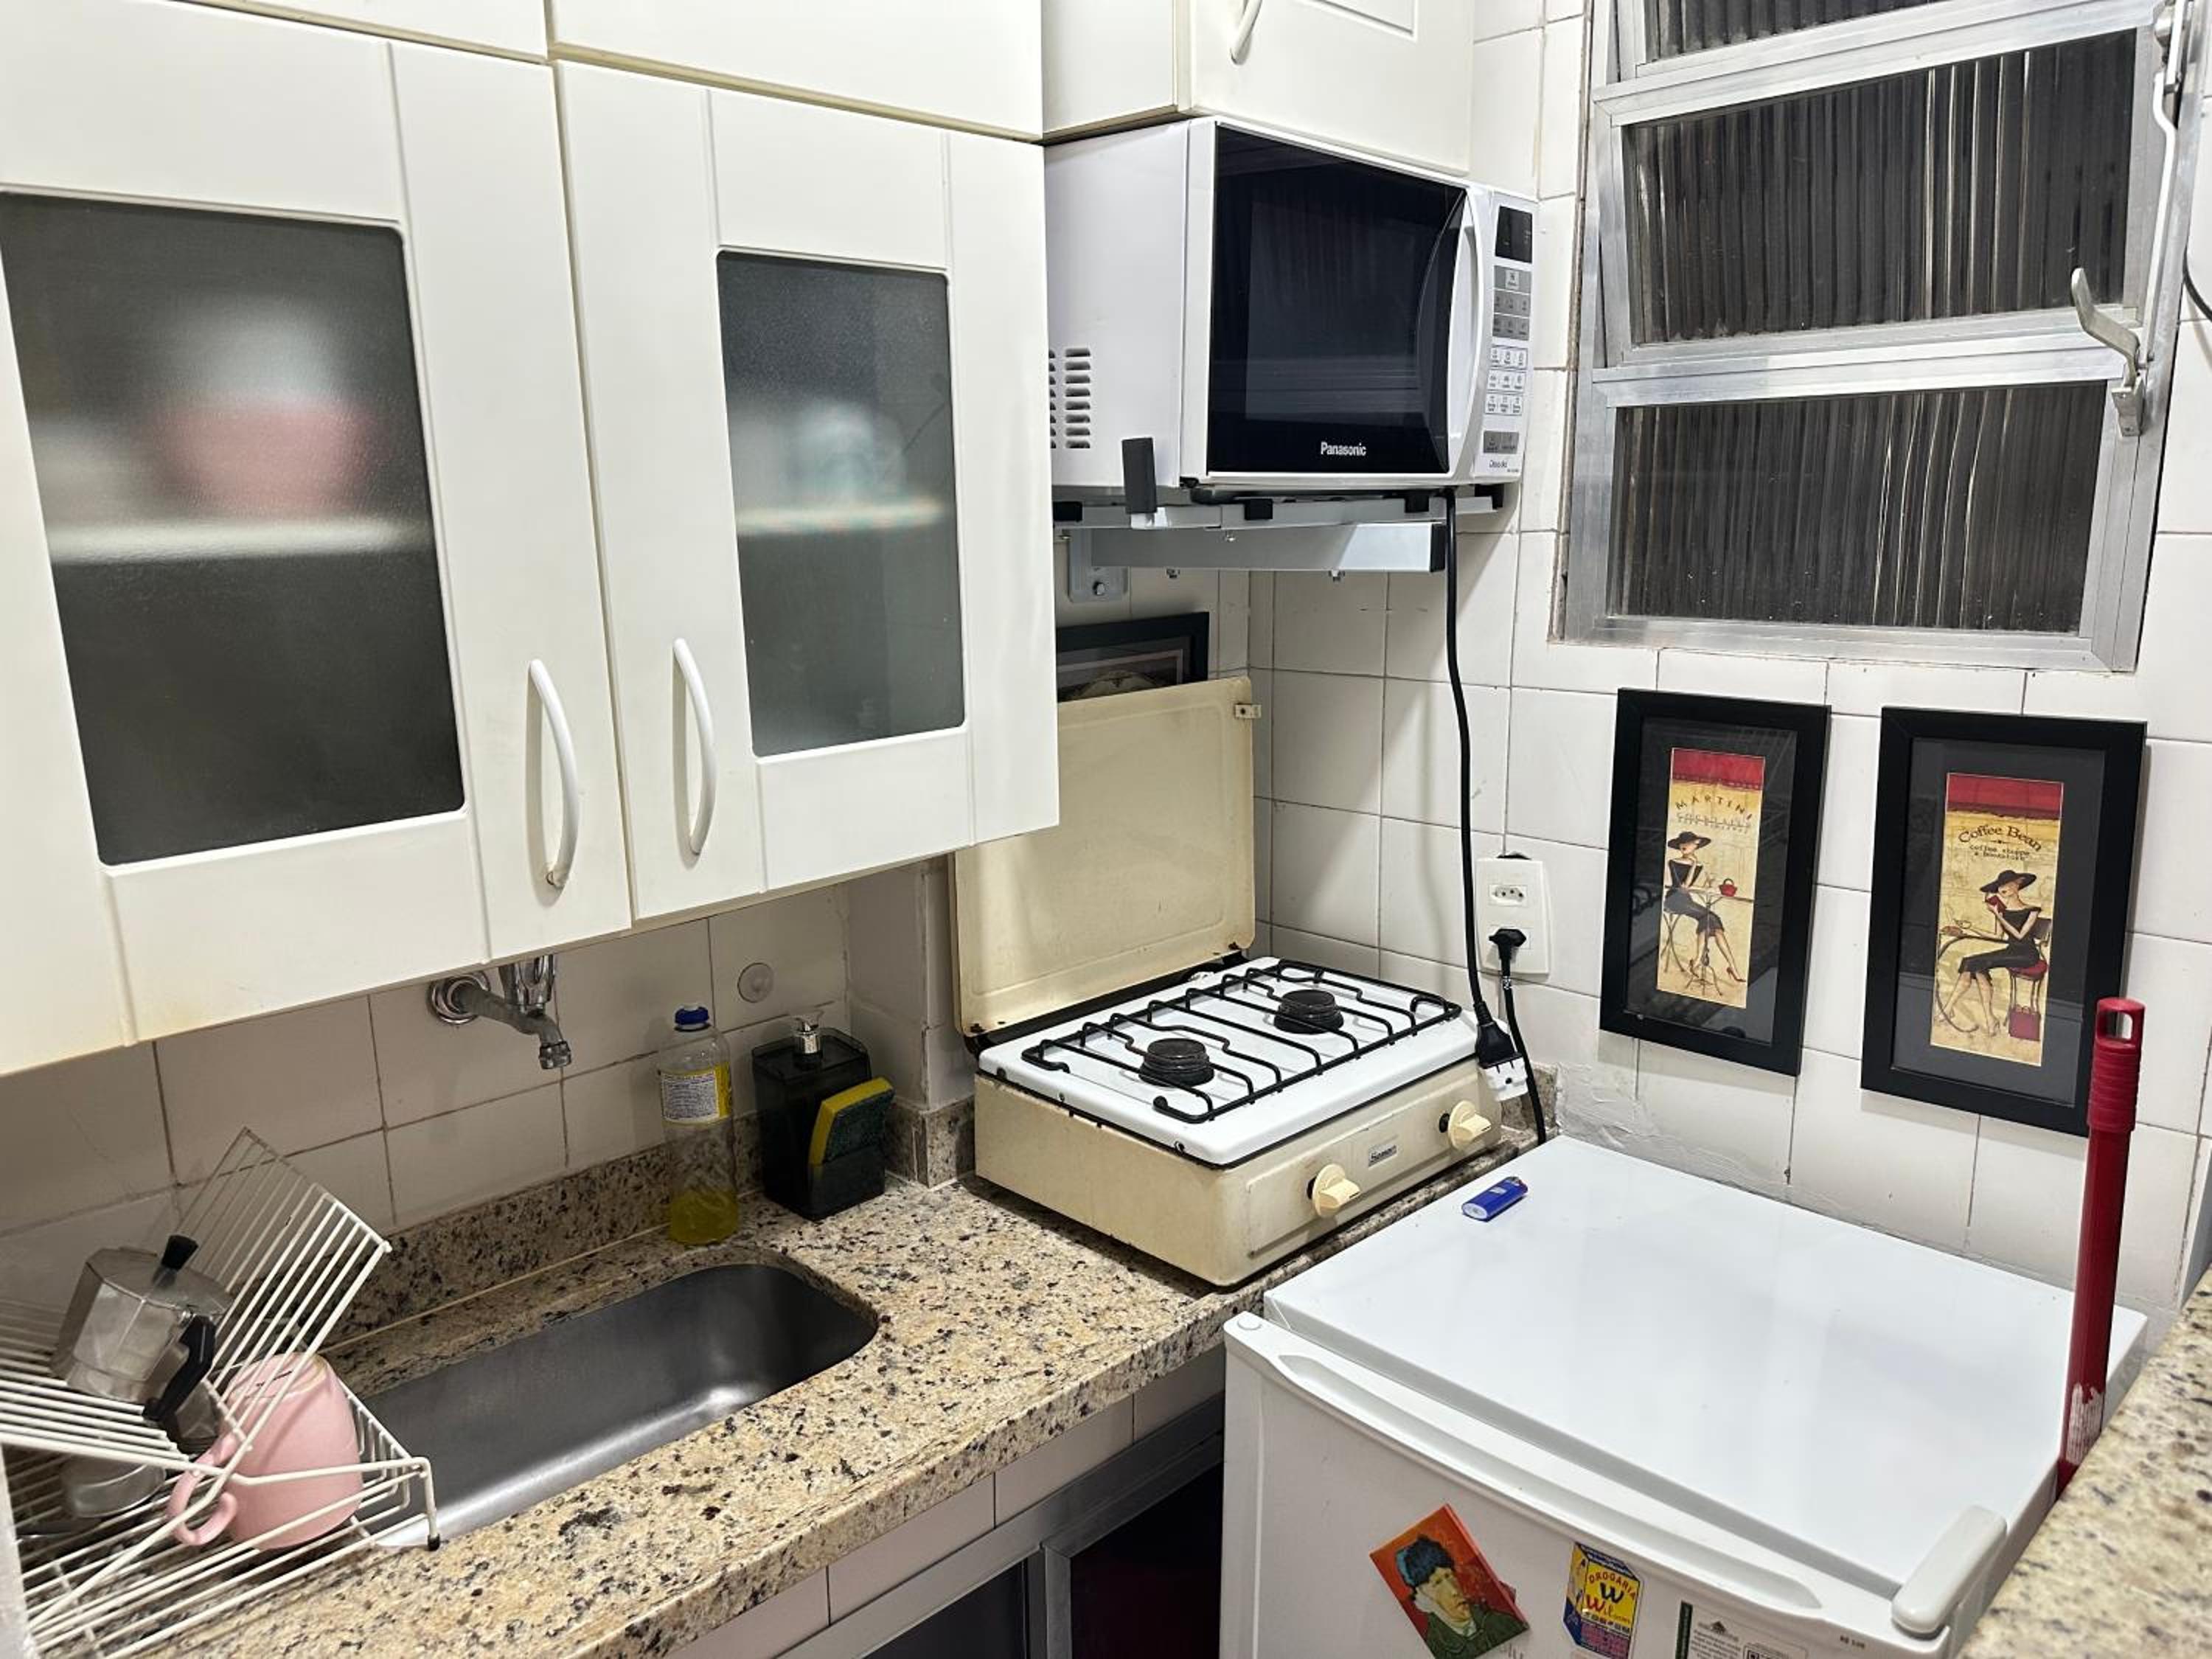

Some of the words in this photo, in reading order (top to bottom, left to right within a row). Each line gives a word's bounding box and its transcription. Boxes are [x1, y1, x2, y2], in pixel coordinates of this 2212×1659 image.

[1321, 441, 1367, 456] Panasonic
[1958, 824, 2003, 843] Coffee
[2006, 826, 2042, 852] Bean
[1588, 1571, 1636, 1601] DROGARIA
[1600, 1582, 1625, 1604] W
